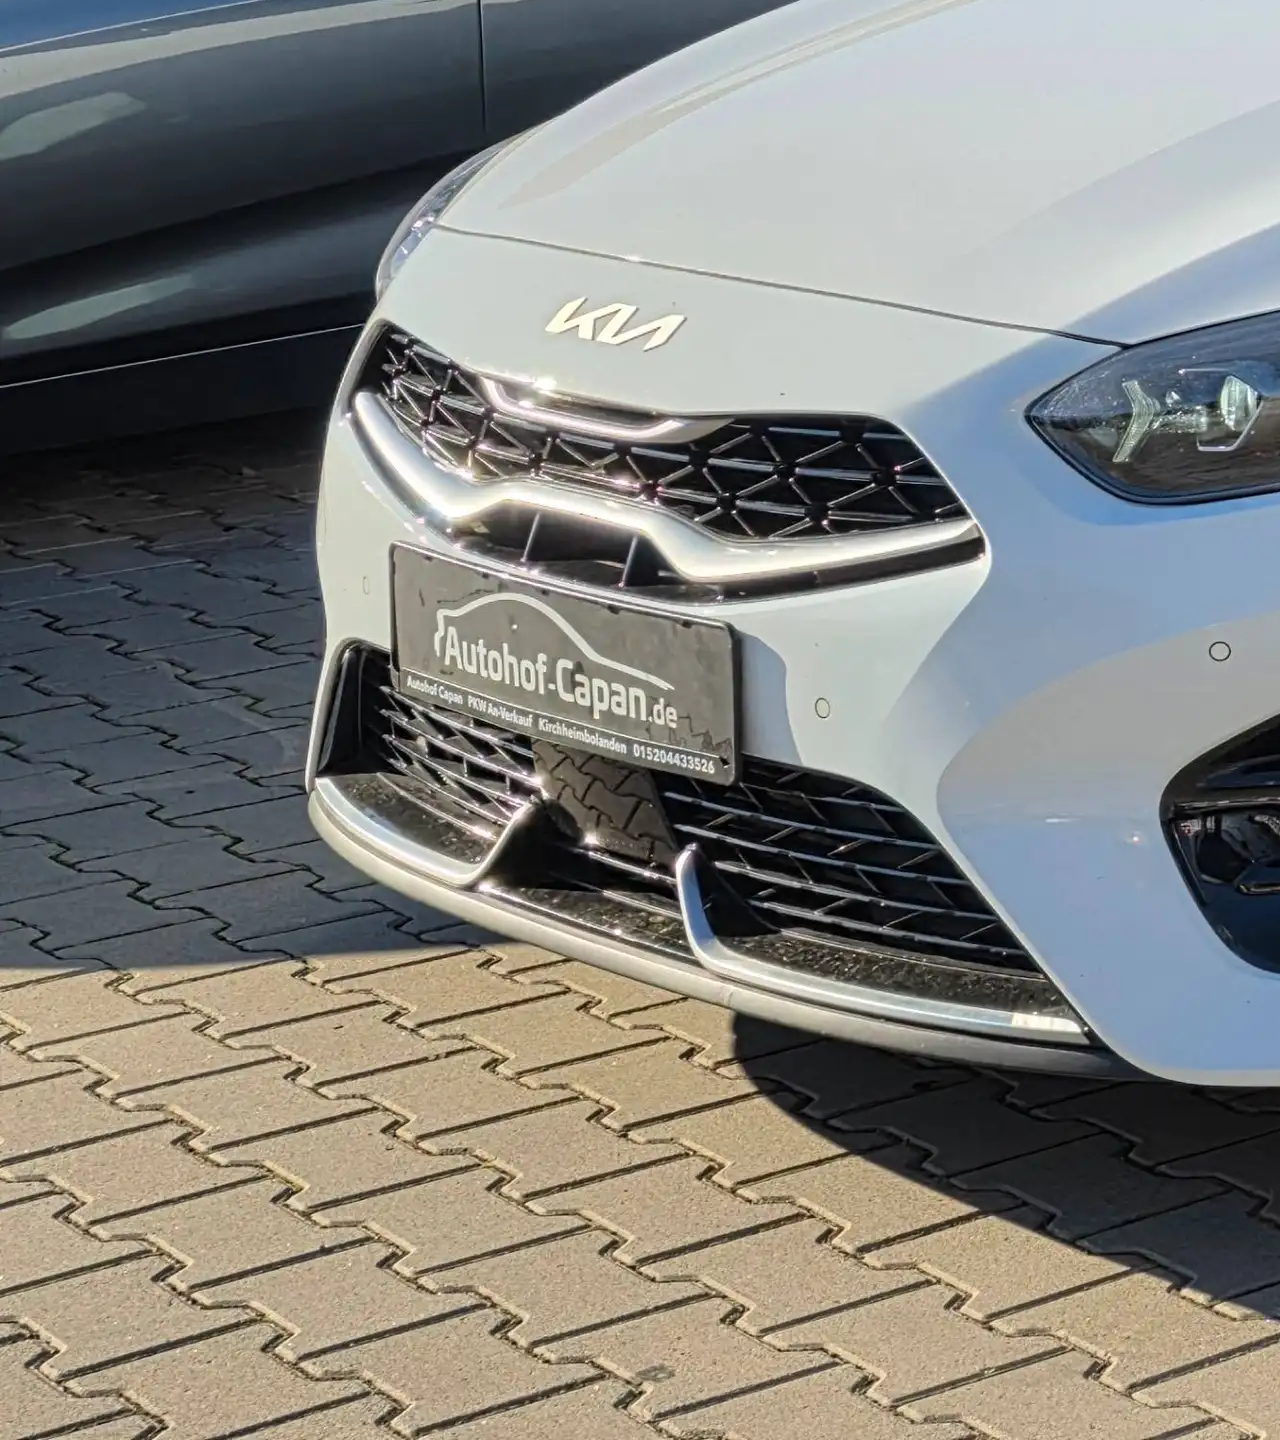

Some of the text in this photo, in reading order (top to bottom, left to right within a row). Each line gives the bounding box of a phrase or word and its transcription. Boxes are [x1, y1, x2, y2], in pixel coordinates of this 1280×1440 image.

[545, 296, 687, 353] KIA
[406, 675, 716, 774] Autohof Capan PKW An-Verkauf Kirchheimbolanden 015204433526
